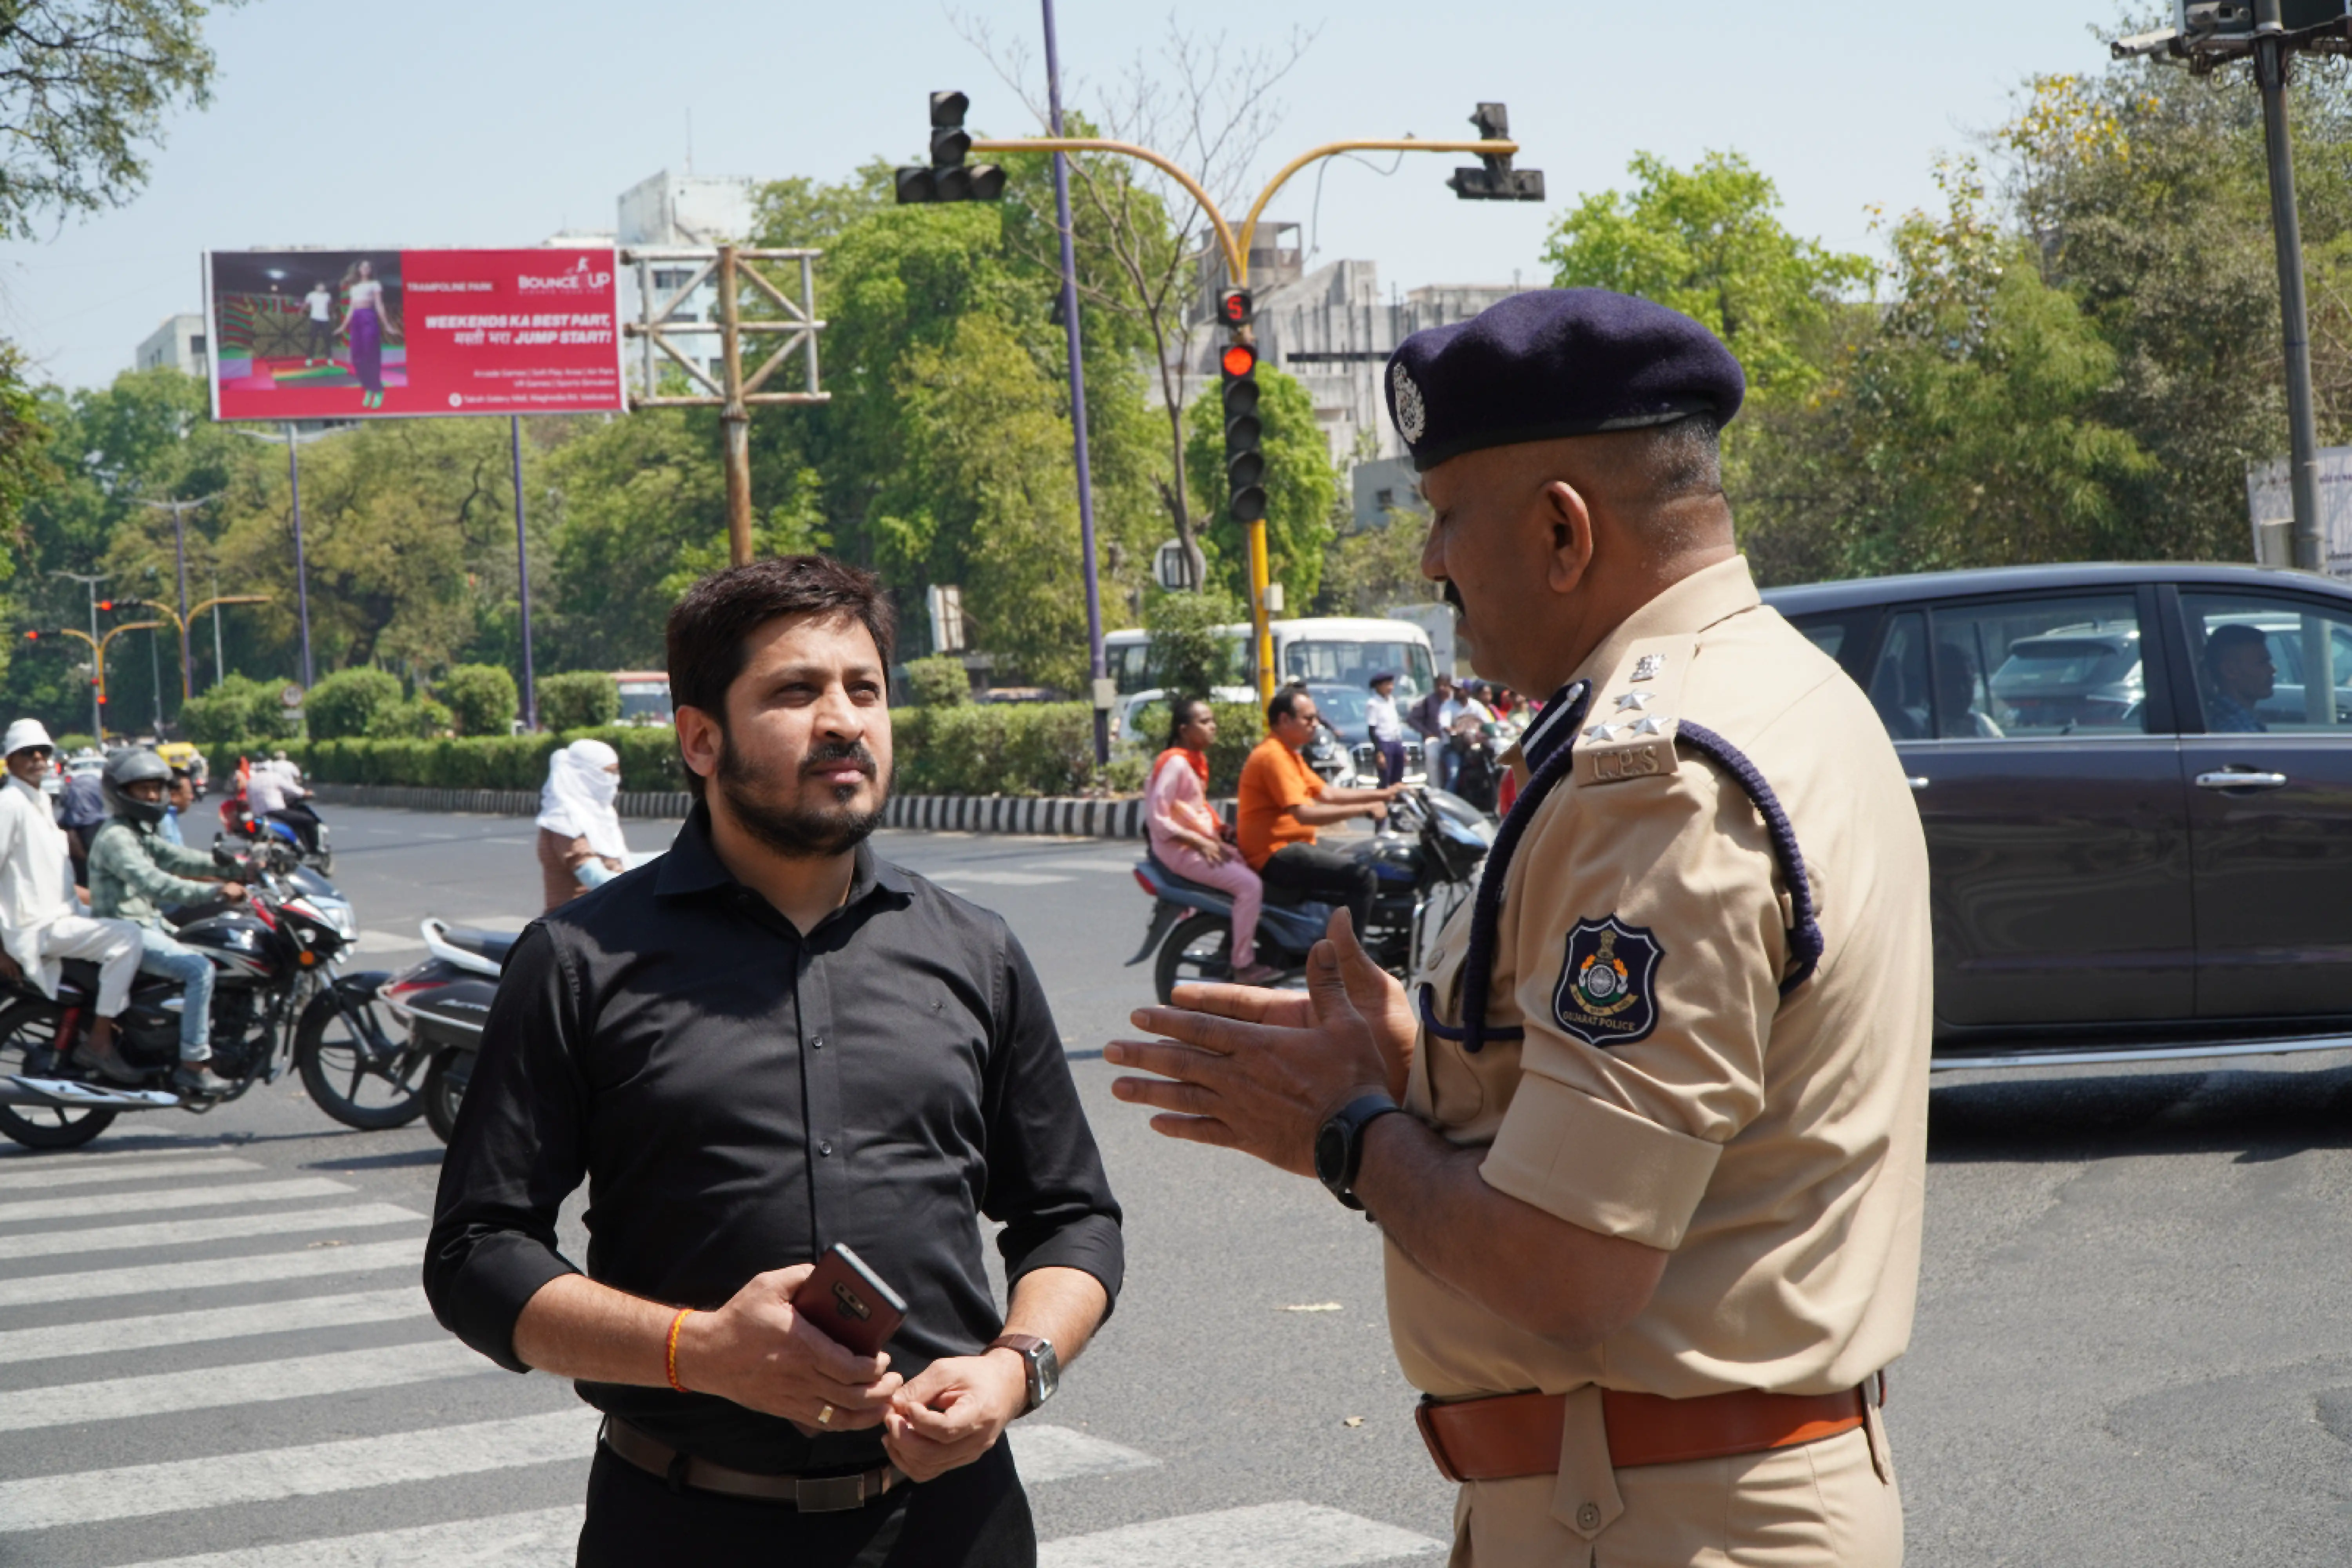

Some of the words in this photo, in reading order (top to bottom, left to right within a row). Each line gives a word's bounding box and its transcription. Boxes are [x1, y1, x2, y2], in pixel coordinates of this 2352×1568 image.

[518, 275, 578, 289] BOUNCE
[588, 272, 611, 288] UP
[425, 315, 507, 328] WEEKENDS
[510, 314, 529, 327] KA
[532, 314, 568, 327] BEST
[514, 331, 557, 344] JUMP
[1598, 1017, 1636, 1031] POLICE
